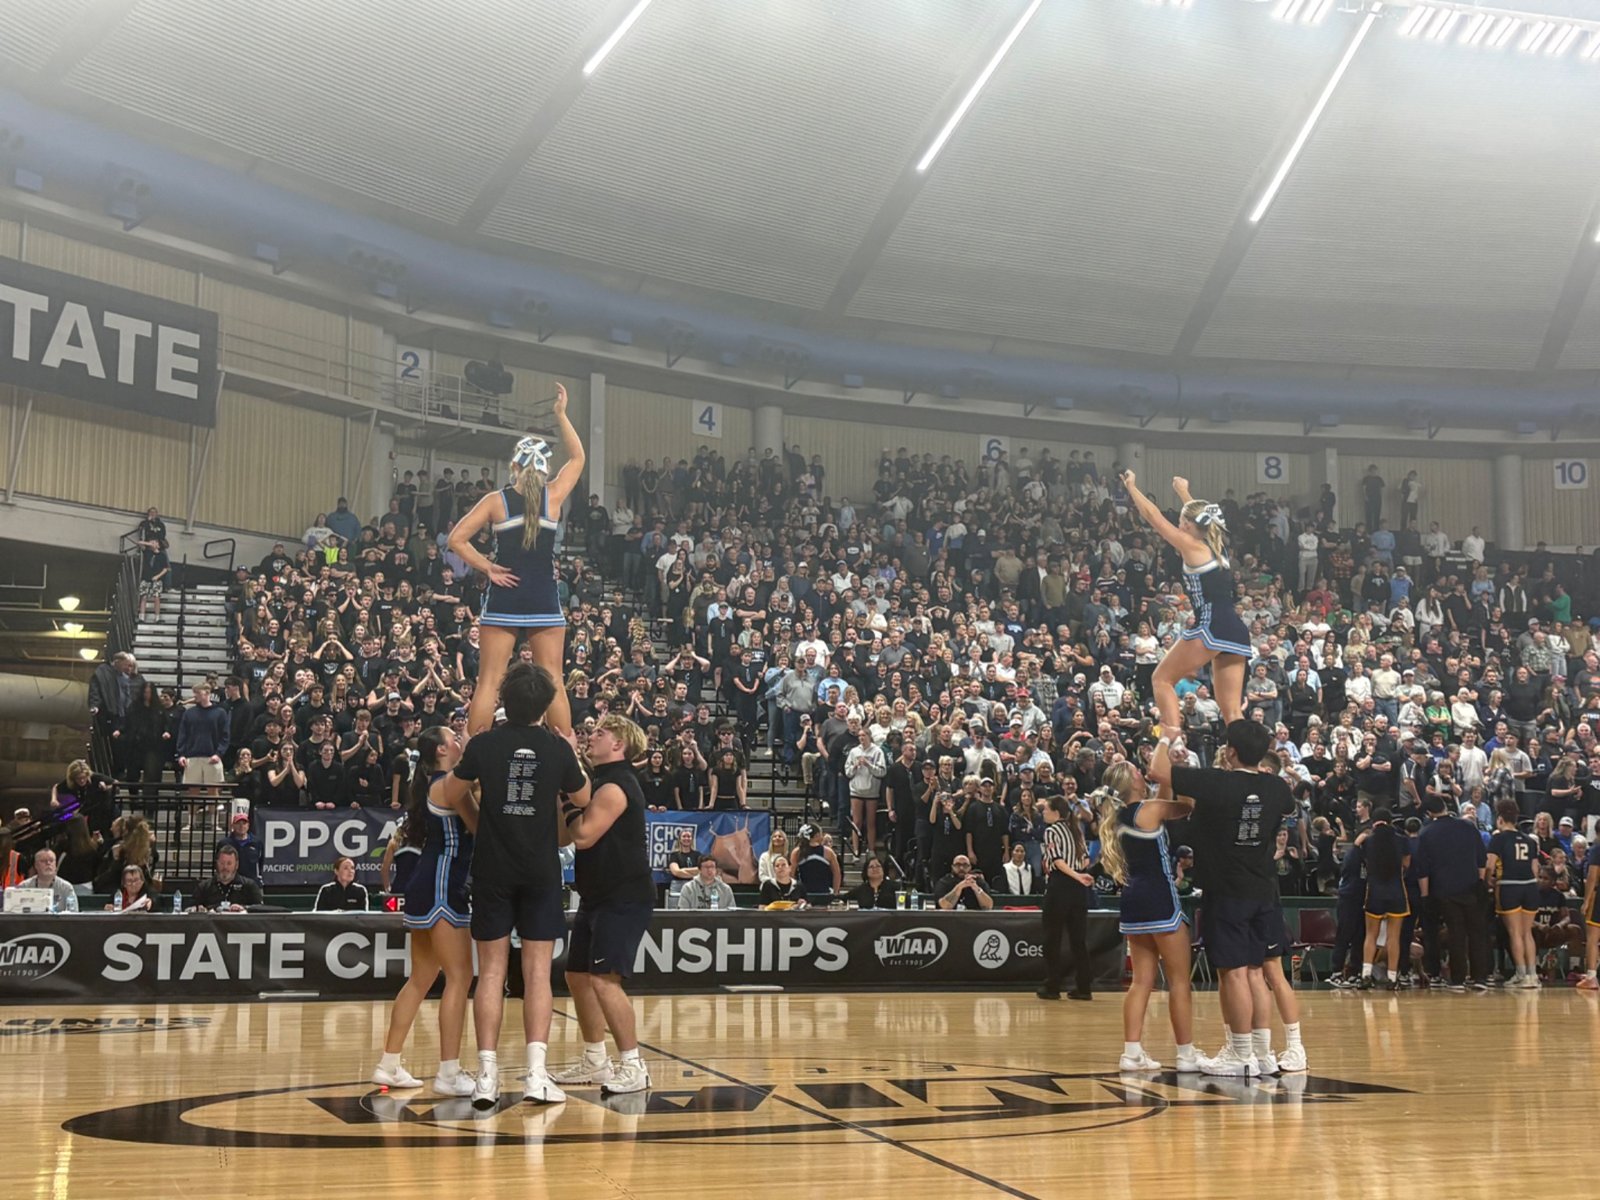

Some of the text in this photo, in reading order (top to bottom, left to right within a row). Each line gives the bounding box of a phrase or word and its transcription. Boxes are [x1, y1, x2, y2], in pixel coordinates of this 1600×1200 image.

[400, 351, 420, 380] 2
[698, 405, 716, 432] 4
[985, 438, 1003, 461] 6
[1263, 456, 1282, 480] 8
[1554, 461, 1587, 485] 10
[1515, 843, 1529, 860] 12
[263, 863, 294, 873] PACIFIC
[101, 926, 849, 982] STATE CHNSHIPS
[886, 937, 937, 956] WIAA
